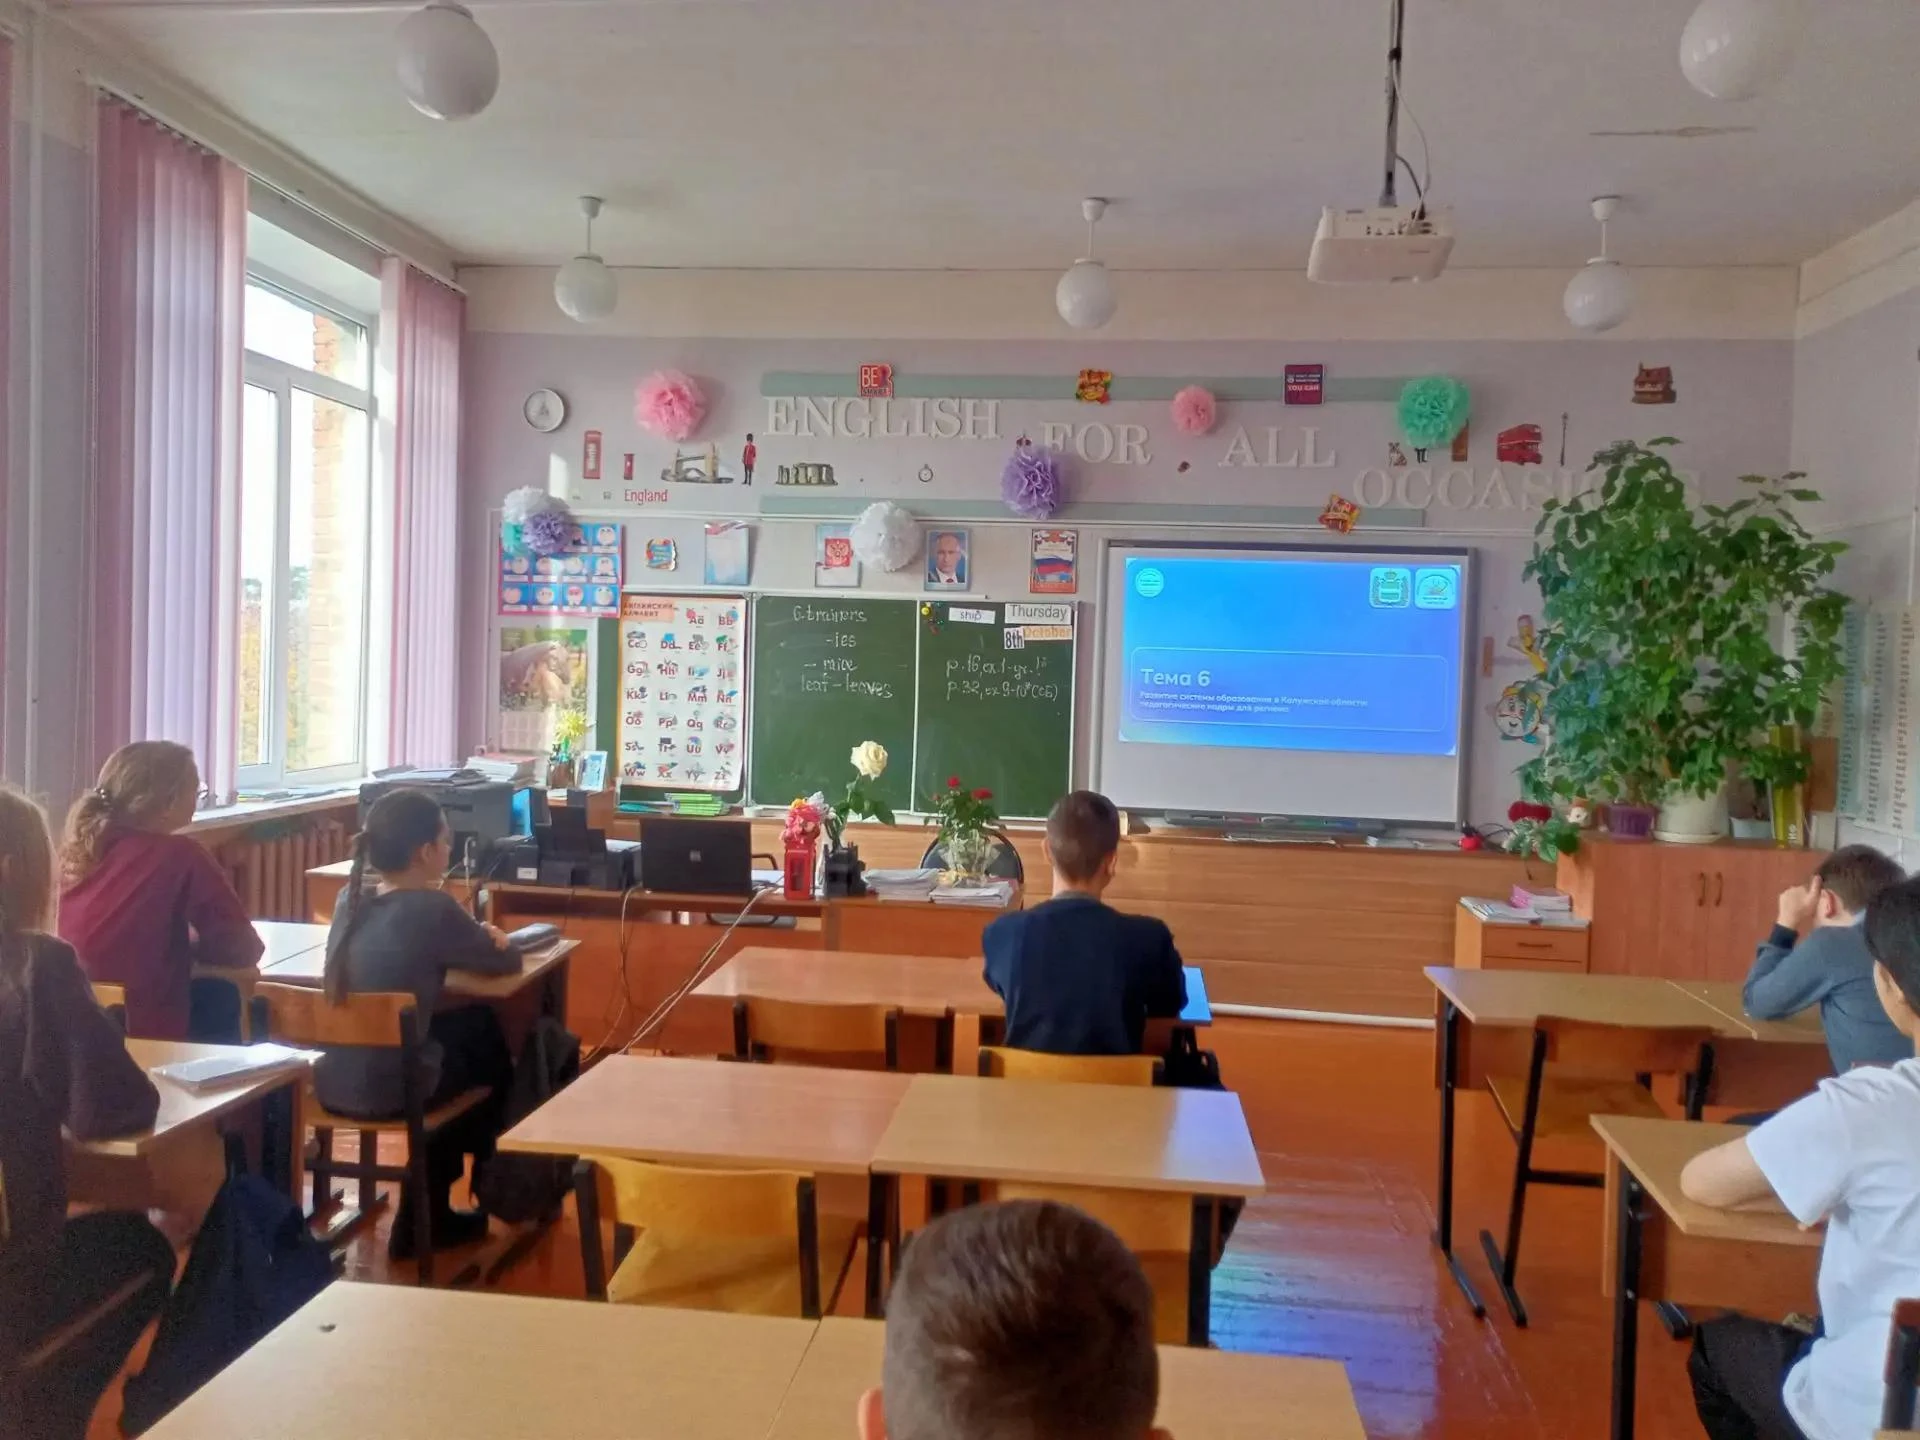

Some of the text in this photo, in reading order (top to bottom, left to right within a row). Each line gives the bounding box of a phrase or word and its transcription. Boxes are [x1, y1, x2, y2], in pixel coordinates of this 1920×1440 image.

[862, 367, 878, 387] BE
[763, 397, 1002, 438] ENGLISH
[1040, 421, 1152, 465] FOR
[1218, 425, 1335, 468] ALL
[624, 489, 668, 506] England
[1008, 604, 1068, 621] Thursday
[718, 616, 733, 626] Bb
[1005, 627, 1071, 648] 8th October
[660, 640, 676, 649] Dd
[717, 642, 728, 651] Ff
[628, 665, 644, 676] Gg
[660, 666, 675, 676] Hh
[717, 668, 726, 678] Jj
[1140, 668, 1210, 686] Тема 6
[626, 690, 640, 700] Kk
[688, 693, 707, 702] Mm
[716, 693, 732, 703] Nn
[626, 716, 642, 725] Oo
[659, 717, 672, 728] Pp
[687, 719, 704, 731] Qq
[687, 744, 702, 754] Uu
[625, 768, 646, 777] Ww
